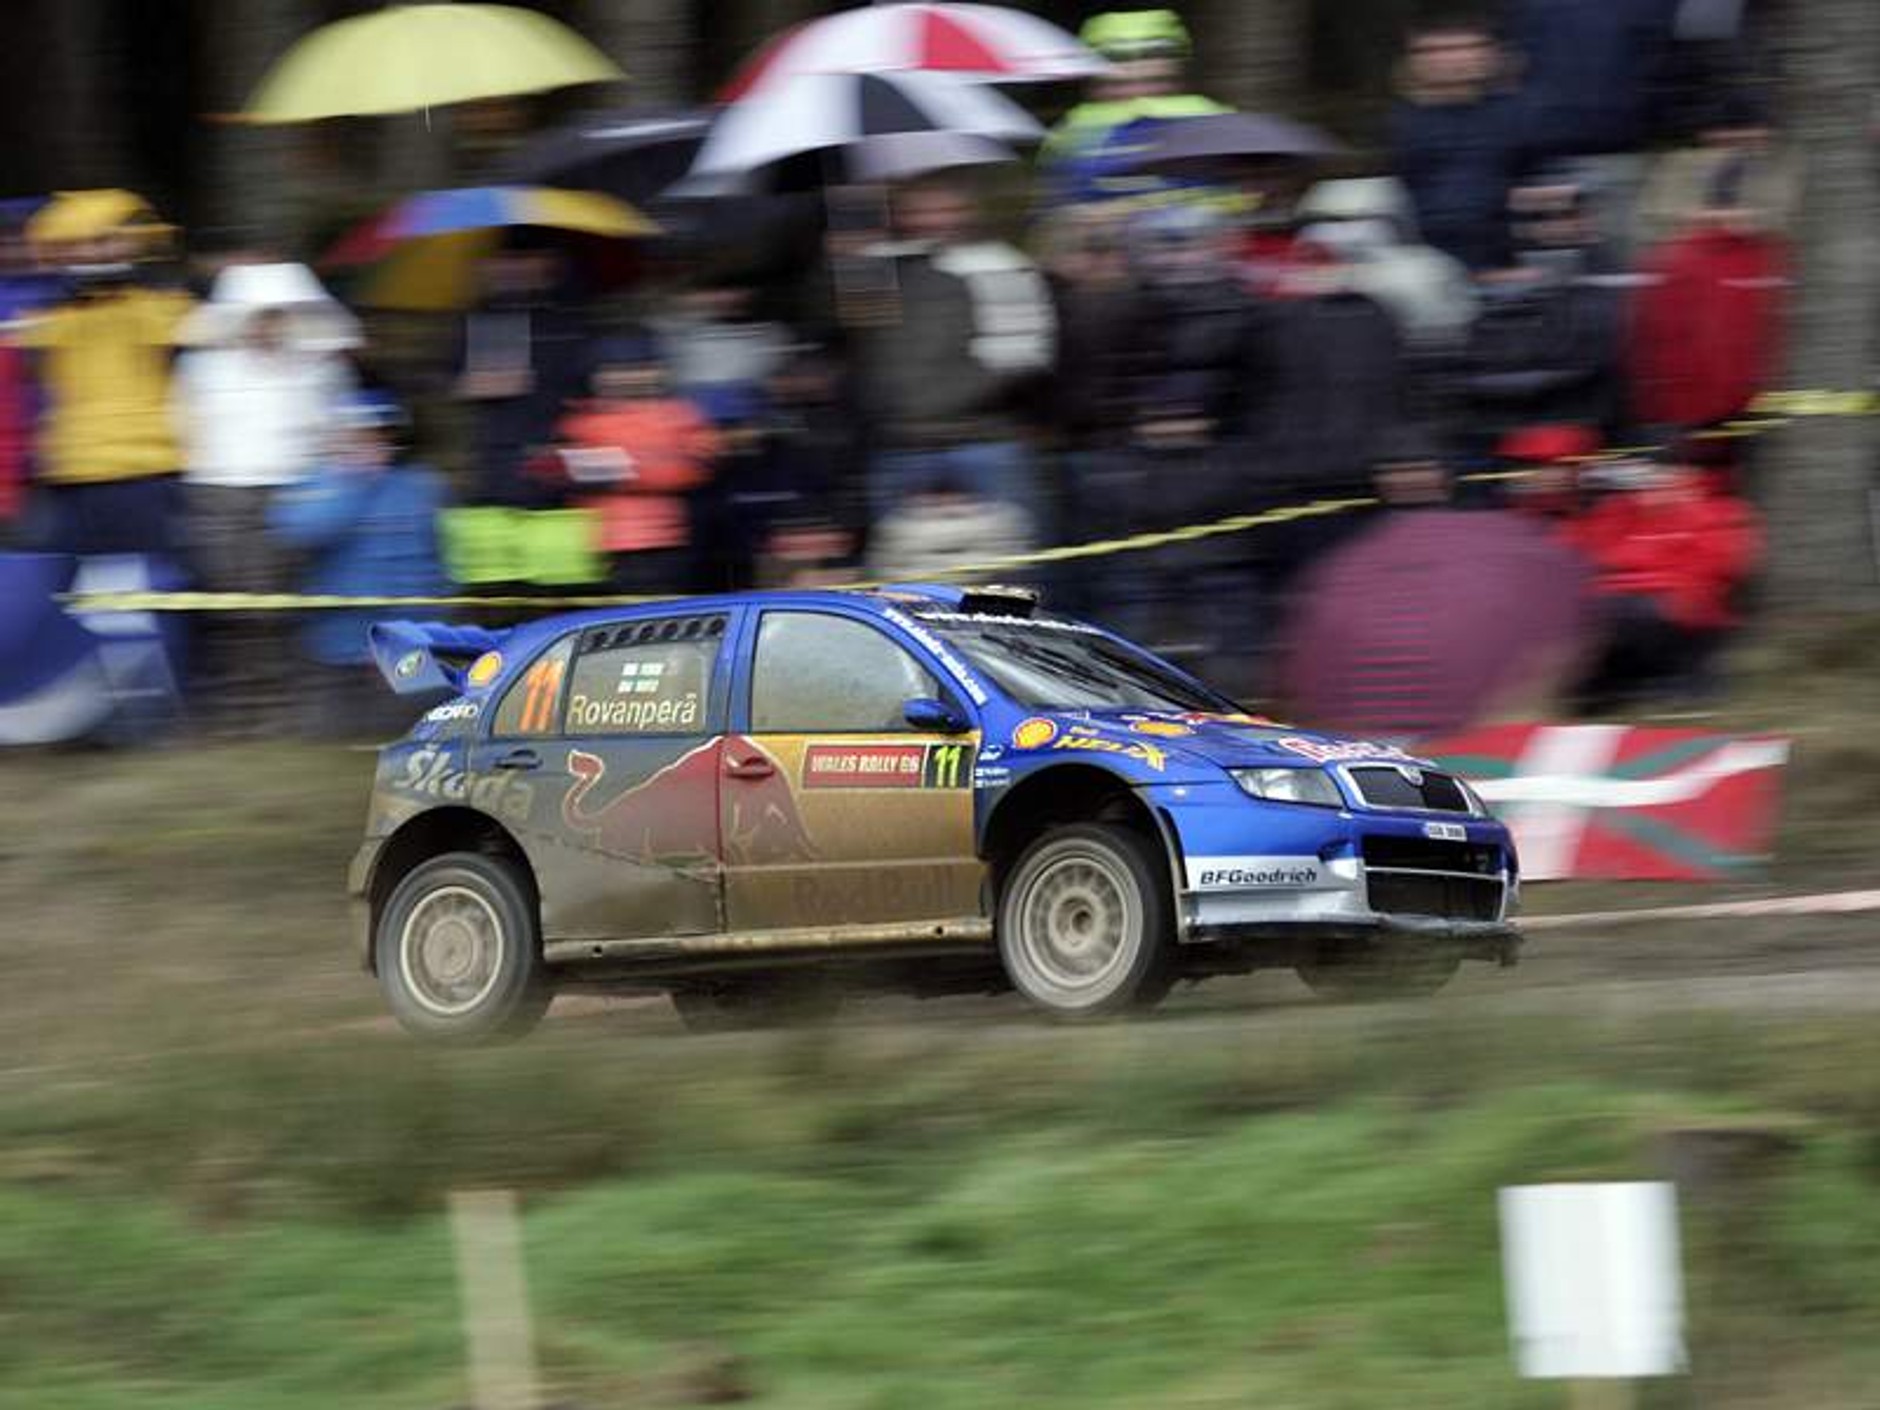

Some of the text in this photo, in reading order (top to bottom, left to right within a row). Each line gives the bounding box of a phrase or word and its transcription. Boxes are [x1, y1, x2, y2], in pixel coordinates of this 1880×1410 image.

[519, 659, 564, 731] 11
[812, 755, 857, 772] WALES
[858, 754, 899, 772] RALLY
[934, 745, 962, 787] 11
[1200, 867, 1318, 885] BFGoodrich
